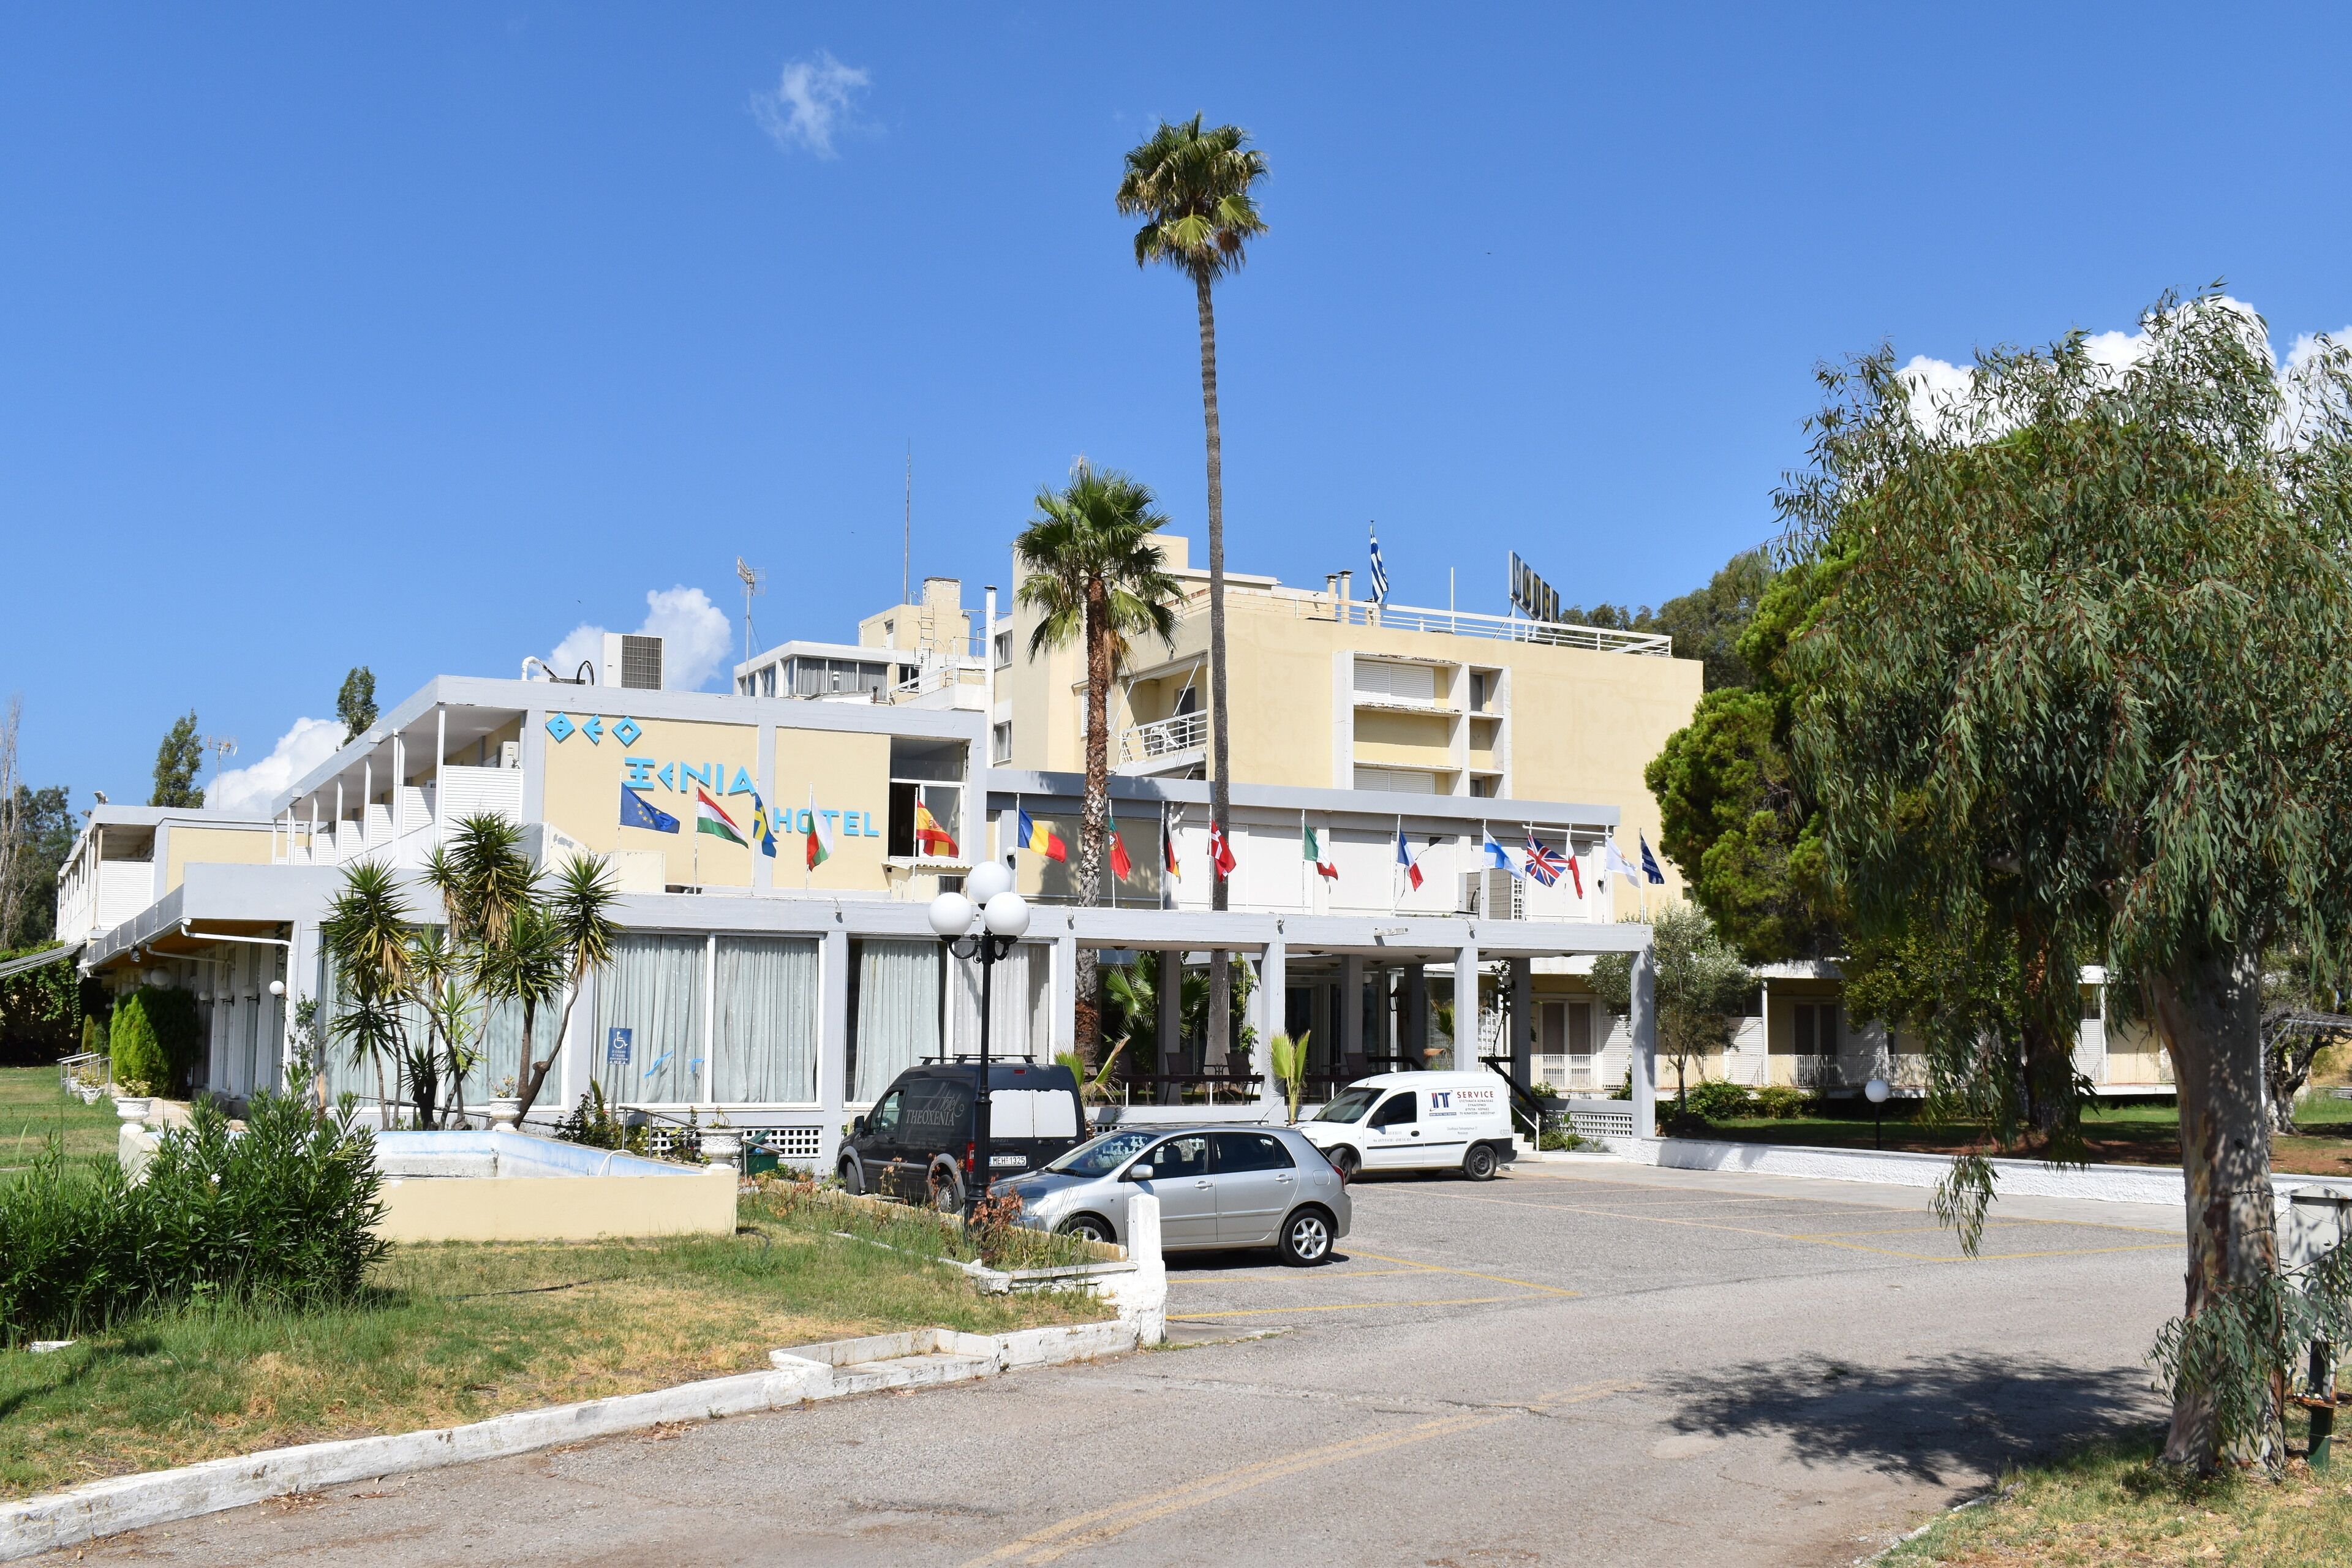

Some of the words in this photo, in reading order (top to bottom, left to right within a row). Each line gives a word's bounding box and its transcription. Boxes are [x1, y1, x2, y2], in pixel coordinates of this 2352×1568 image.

[1513, 552, 1559, 623] HOTEL
[545, 711, 642, 747] ΘΕΟ
[773, 807, 880, 837] HOTEL
[912, 1081, 965, 1117] Hotel
[1431, 1092, 1451, 1109] IT
[906, 1109, 955, 1126] THEOXENIA
